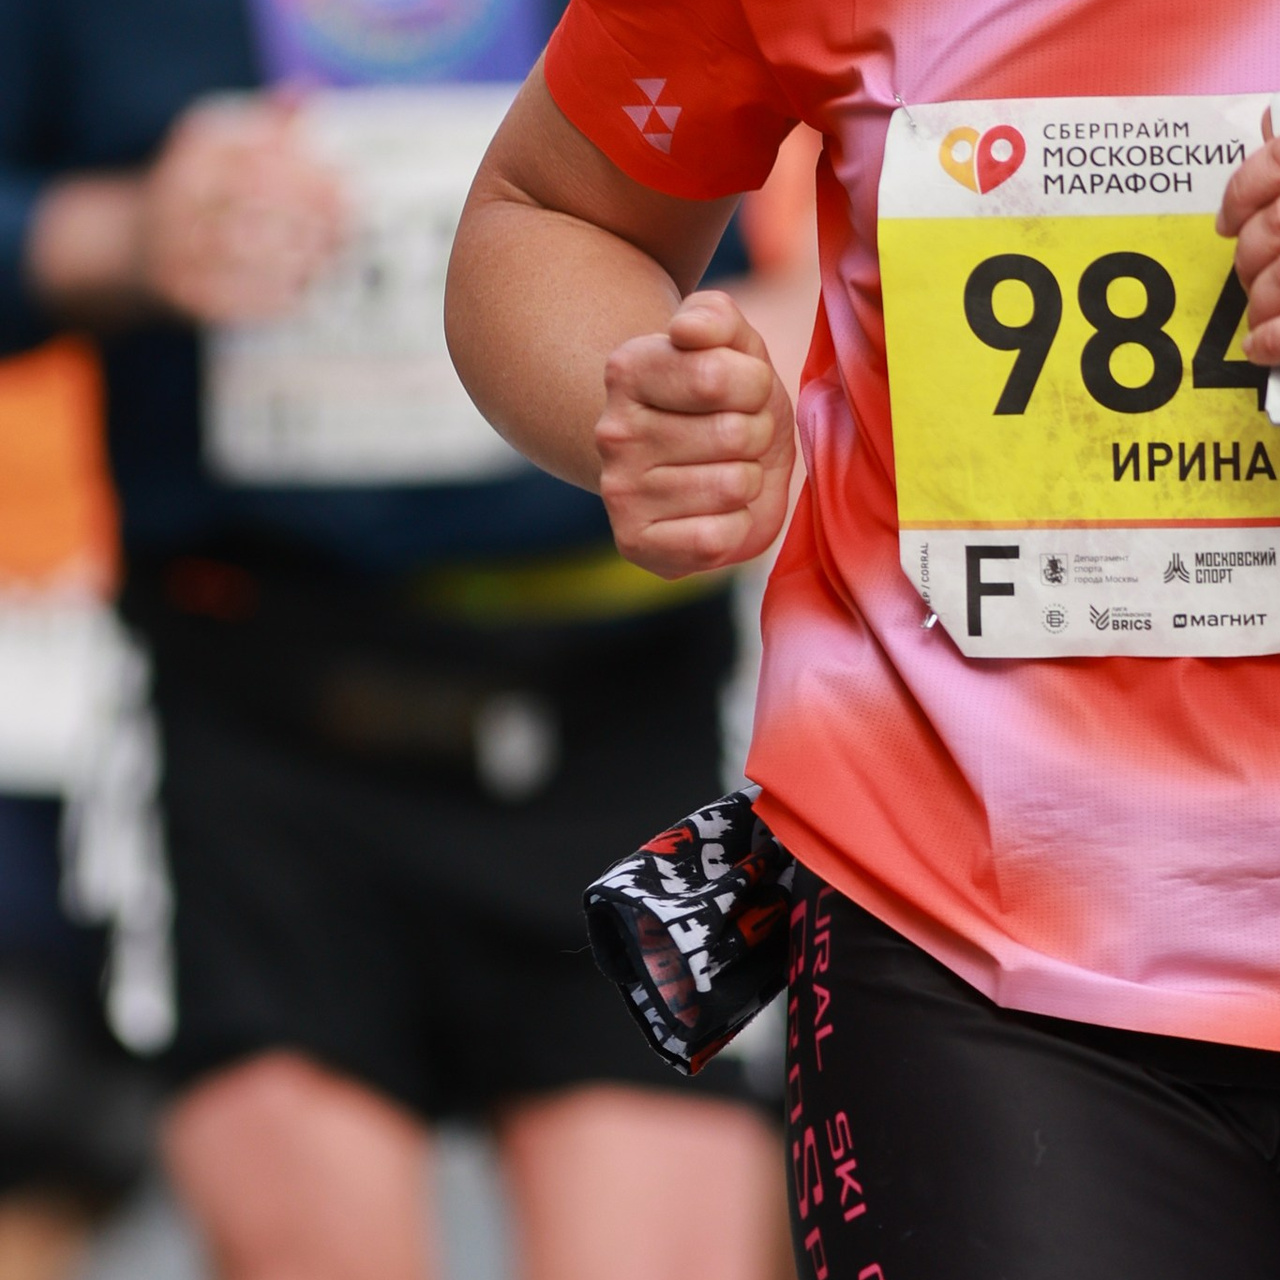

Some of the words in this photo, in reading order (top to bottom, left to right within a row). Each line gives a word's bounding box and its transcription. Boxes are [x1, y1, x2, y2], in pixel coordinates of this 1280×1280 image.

[1043, 118, 1190, 140] СБЕРПРАЙМ
[1043, 138, 1246, 168] МОСКОВСКИЙ
[1043, 172, 1193, 195] МАРАФОН
[1112, 441, 1277, 482] ИРИНА
[921, 543, 930, 582] CORRAL
[1073, 554, 1129, 563] Департамент
[1195, 547, 1276, 567] МОСКОВСКИЙ
[1074, 566, 1102, 574] спорта
[1195, 568, 1233, 584] СПОРТ
[965, 545, 1019, 637] F
[1112, 619, 1152, 631] BRICS
[1191, 614, 1267, 626] магнит
[814, 885, 836, 1072] URAL
[826, 1111, 867, 1222] SKI
